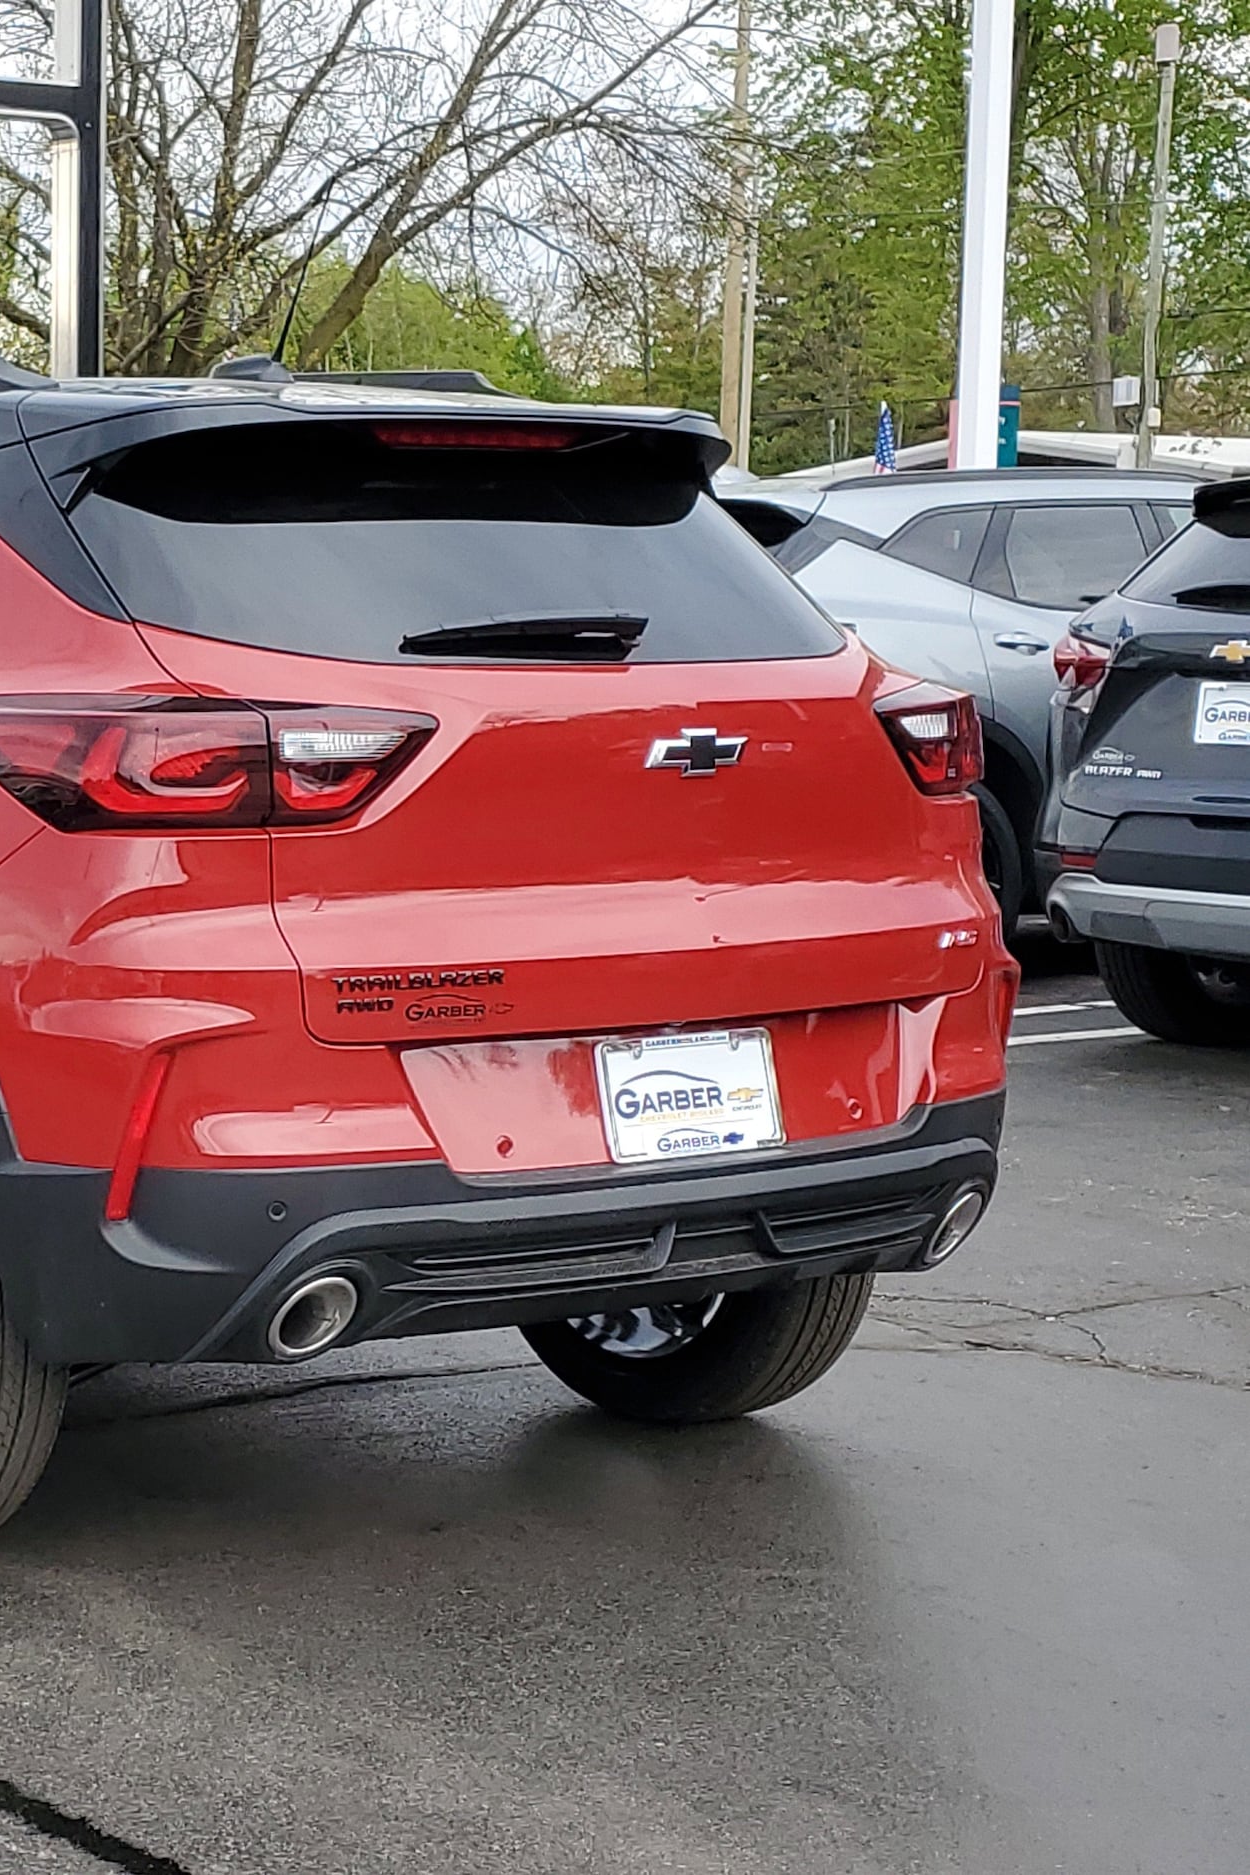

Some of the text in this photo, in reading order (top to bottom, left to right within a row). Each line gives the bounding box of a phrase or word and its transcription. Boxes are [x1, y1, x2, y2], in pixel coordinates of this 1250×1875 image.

[1204, 707, 1250, 723] GARB
[1084, 765, 1133, 777] BLAZER
[331, 968, 505, 994] TRAILBLAZER
[336, 997, 395, 1014] AWD
[405, 1003, 486, 1022] GARBER
[614, 1086, 724, 1119] GARBER
[657, 1135, 720, 1152] GARBER
